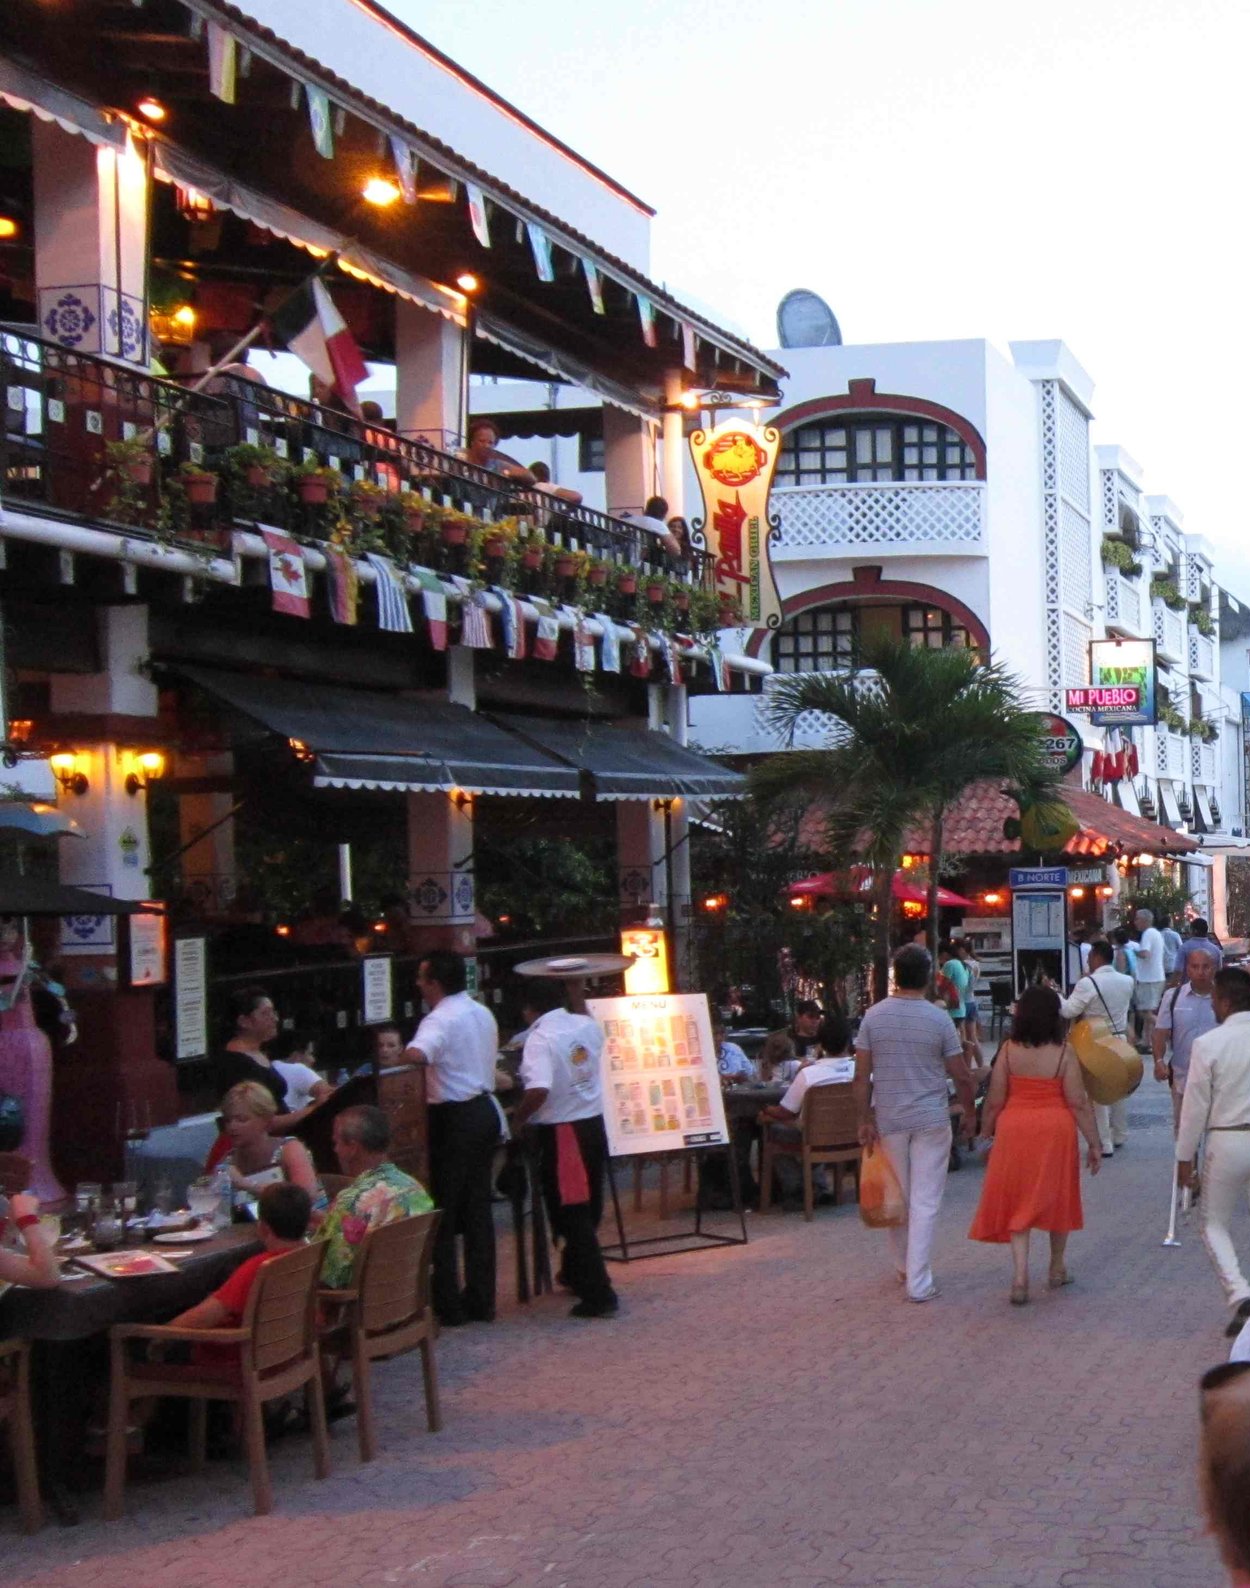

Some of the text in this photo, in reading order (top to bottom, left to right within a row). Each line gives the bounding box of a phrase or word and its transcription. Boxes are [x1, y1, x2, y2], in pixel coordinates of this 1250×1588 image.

[748, 516, 760, 621] MEXICAN GRILL
[1068, 688, 1136, 706] MI PUEBLO
[1097, 704, 1137, 713] MEXICANA
[1027, 872, 1060, 882] NORTE
